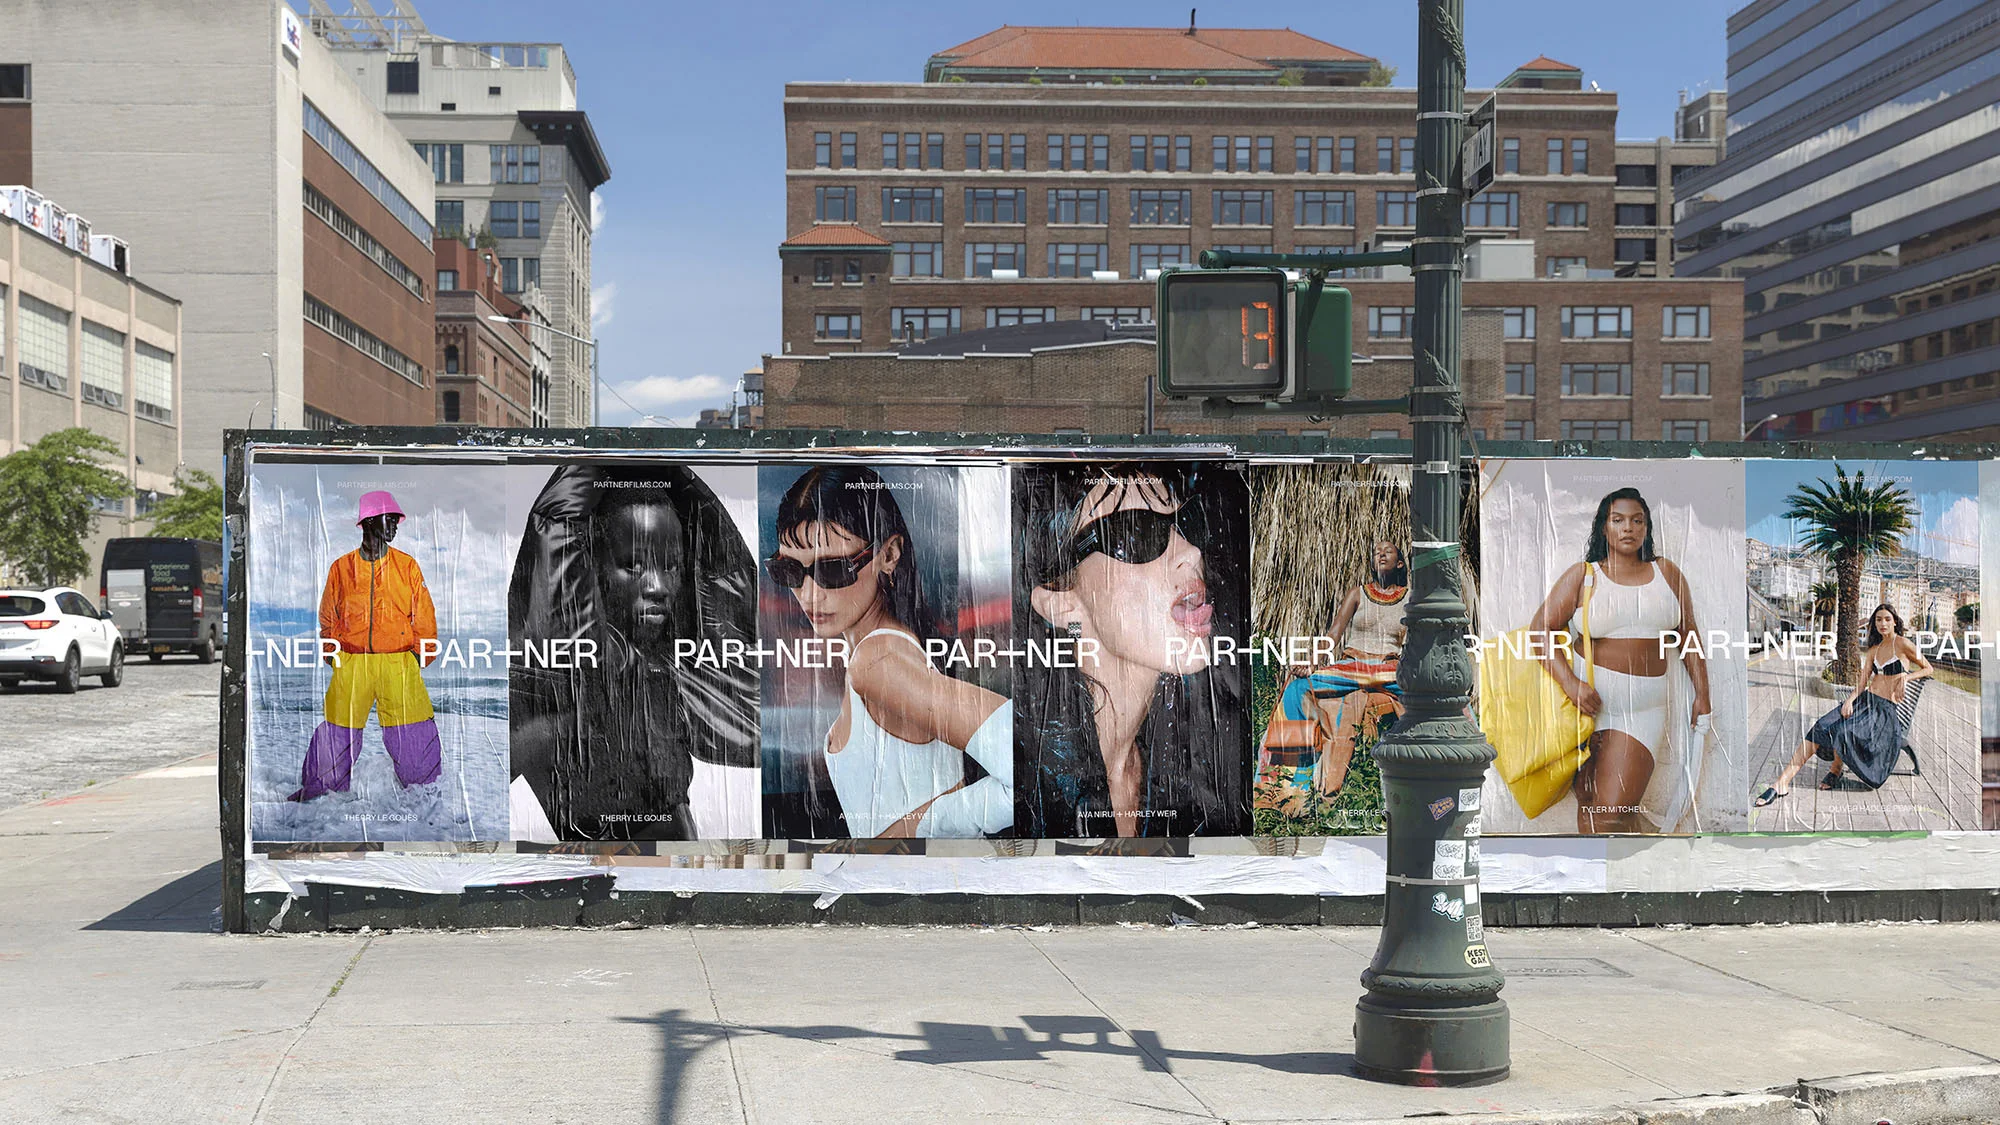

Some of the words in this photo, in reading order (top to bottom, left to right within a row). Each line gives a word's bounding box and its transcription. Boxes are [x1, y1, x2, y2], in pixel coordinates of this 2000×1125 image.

[1241, 301, 1275, 370] 13
[1084, 477, 1163, 486] PARTNERFILMS.COM
[1833, 475, 1913, 483] PARTNERFILMS.COM
[336, 480, 417, 489] PARTNERFILMS.COM
[593, 481, 672, 489] PARTNERFILMS.COM
[844, 482, 923, 490] PARTNERFILMS.COM
[1078, 810, 1094, 819] AVA
[1124, 810, 1156, 818] HARLEY
[1156, 809, 1178, 818] WEIR
[1338, 809, 1370, 817] THERRY
[1581, 805, 1608, 814] TYLER
[1608, 805, 1649, 813] MITCHELL
[378, 813, 388, 822] LE
[600, 814, 632, 822] THERRY
[632, 814, 643, 822] LE
